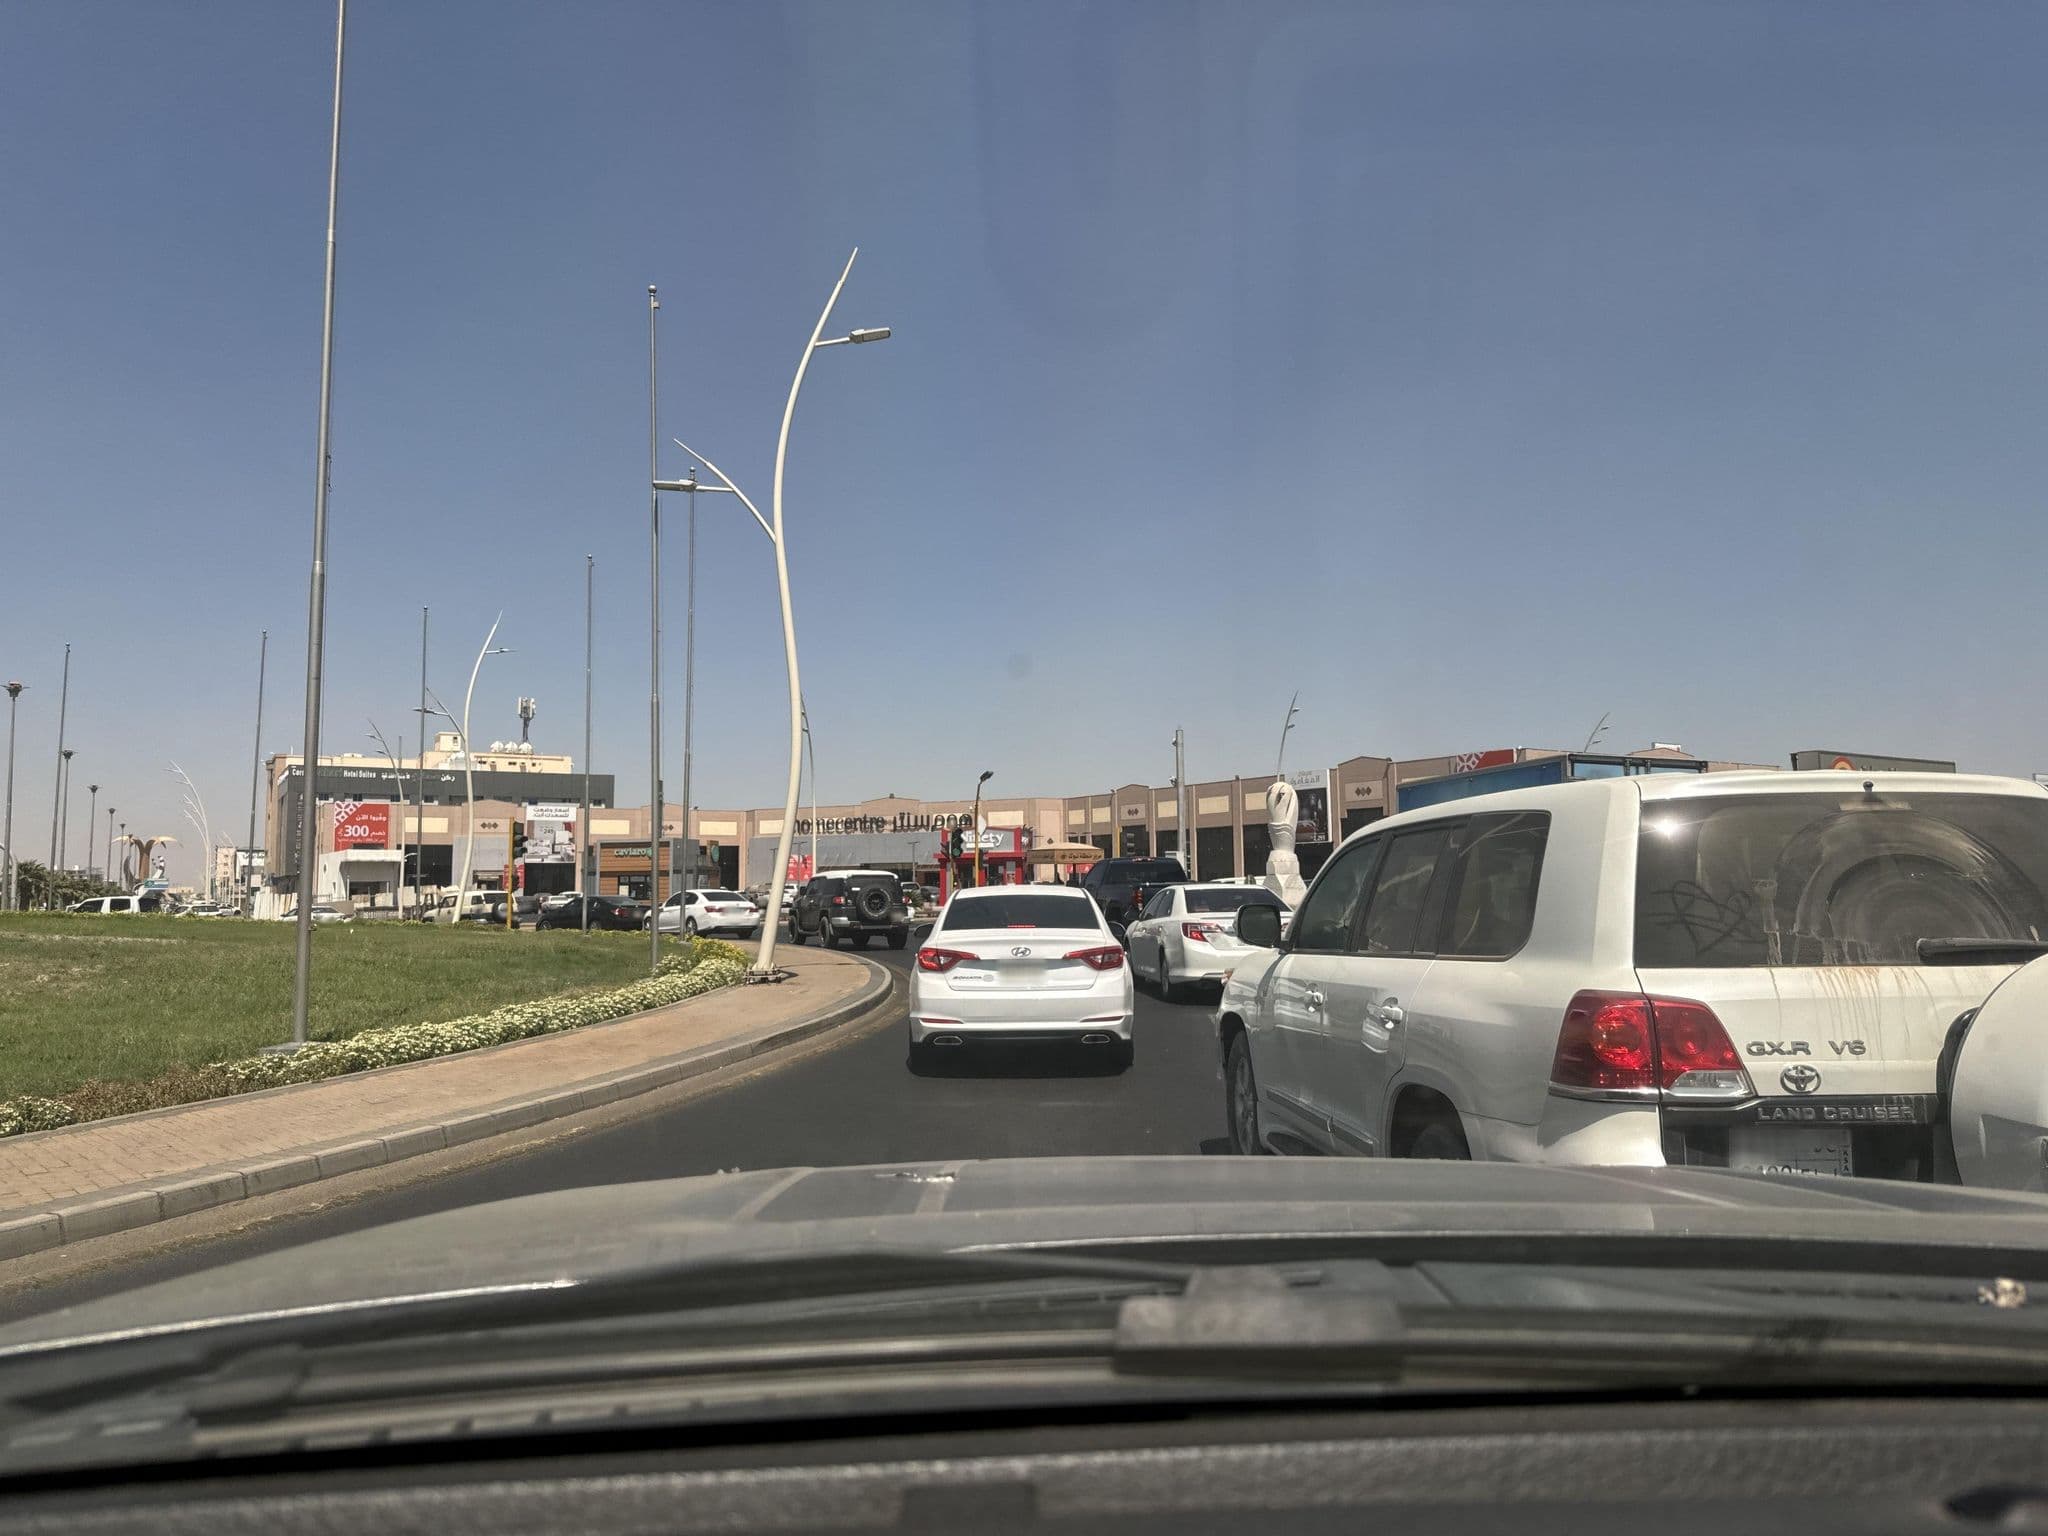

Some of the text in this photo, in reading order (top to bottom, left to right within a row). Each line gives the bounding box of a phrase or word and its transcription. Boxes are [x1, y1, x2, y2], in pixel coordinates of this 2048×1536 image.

[343, 824, 370, 838] 300
[1757, 1106, 1915, 1121] LAND CRUISER
